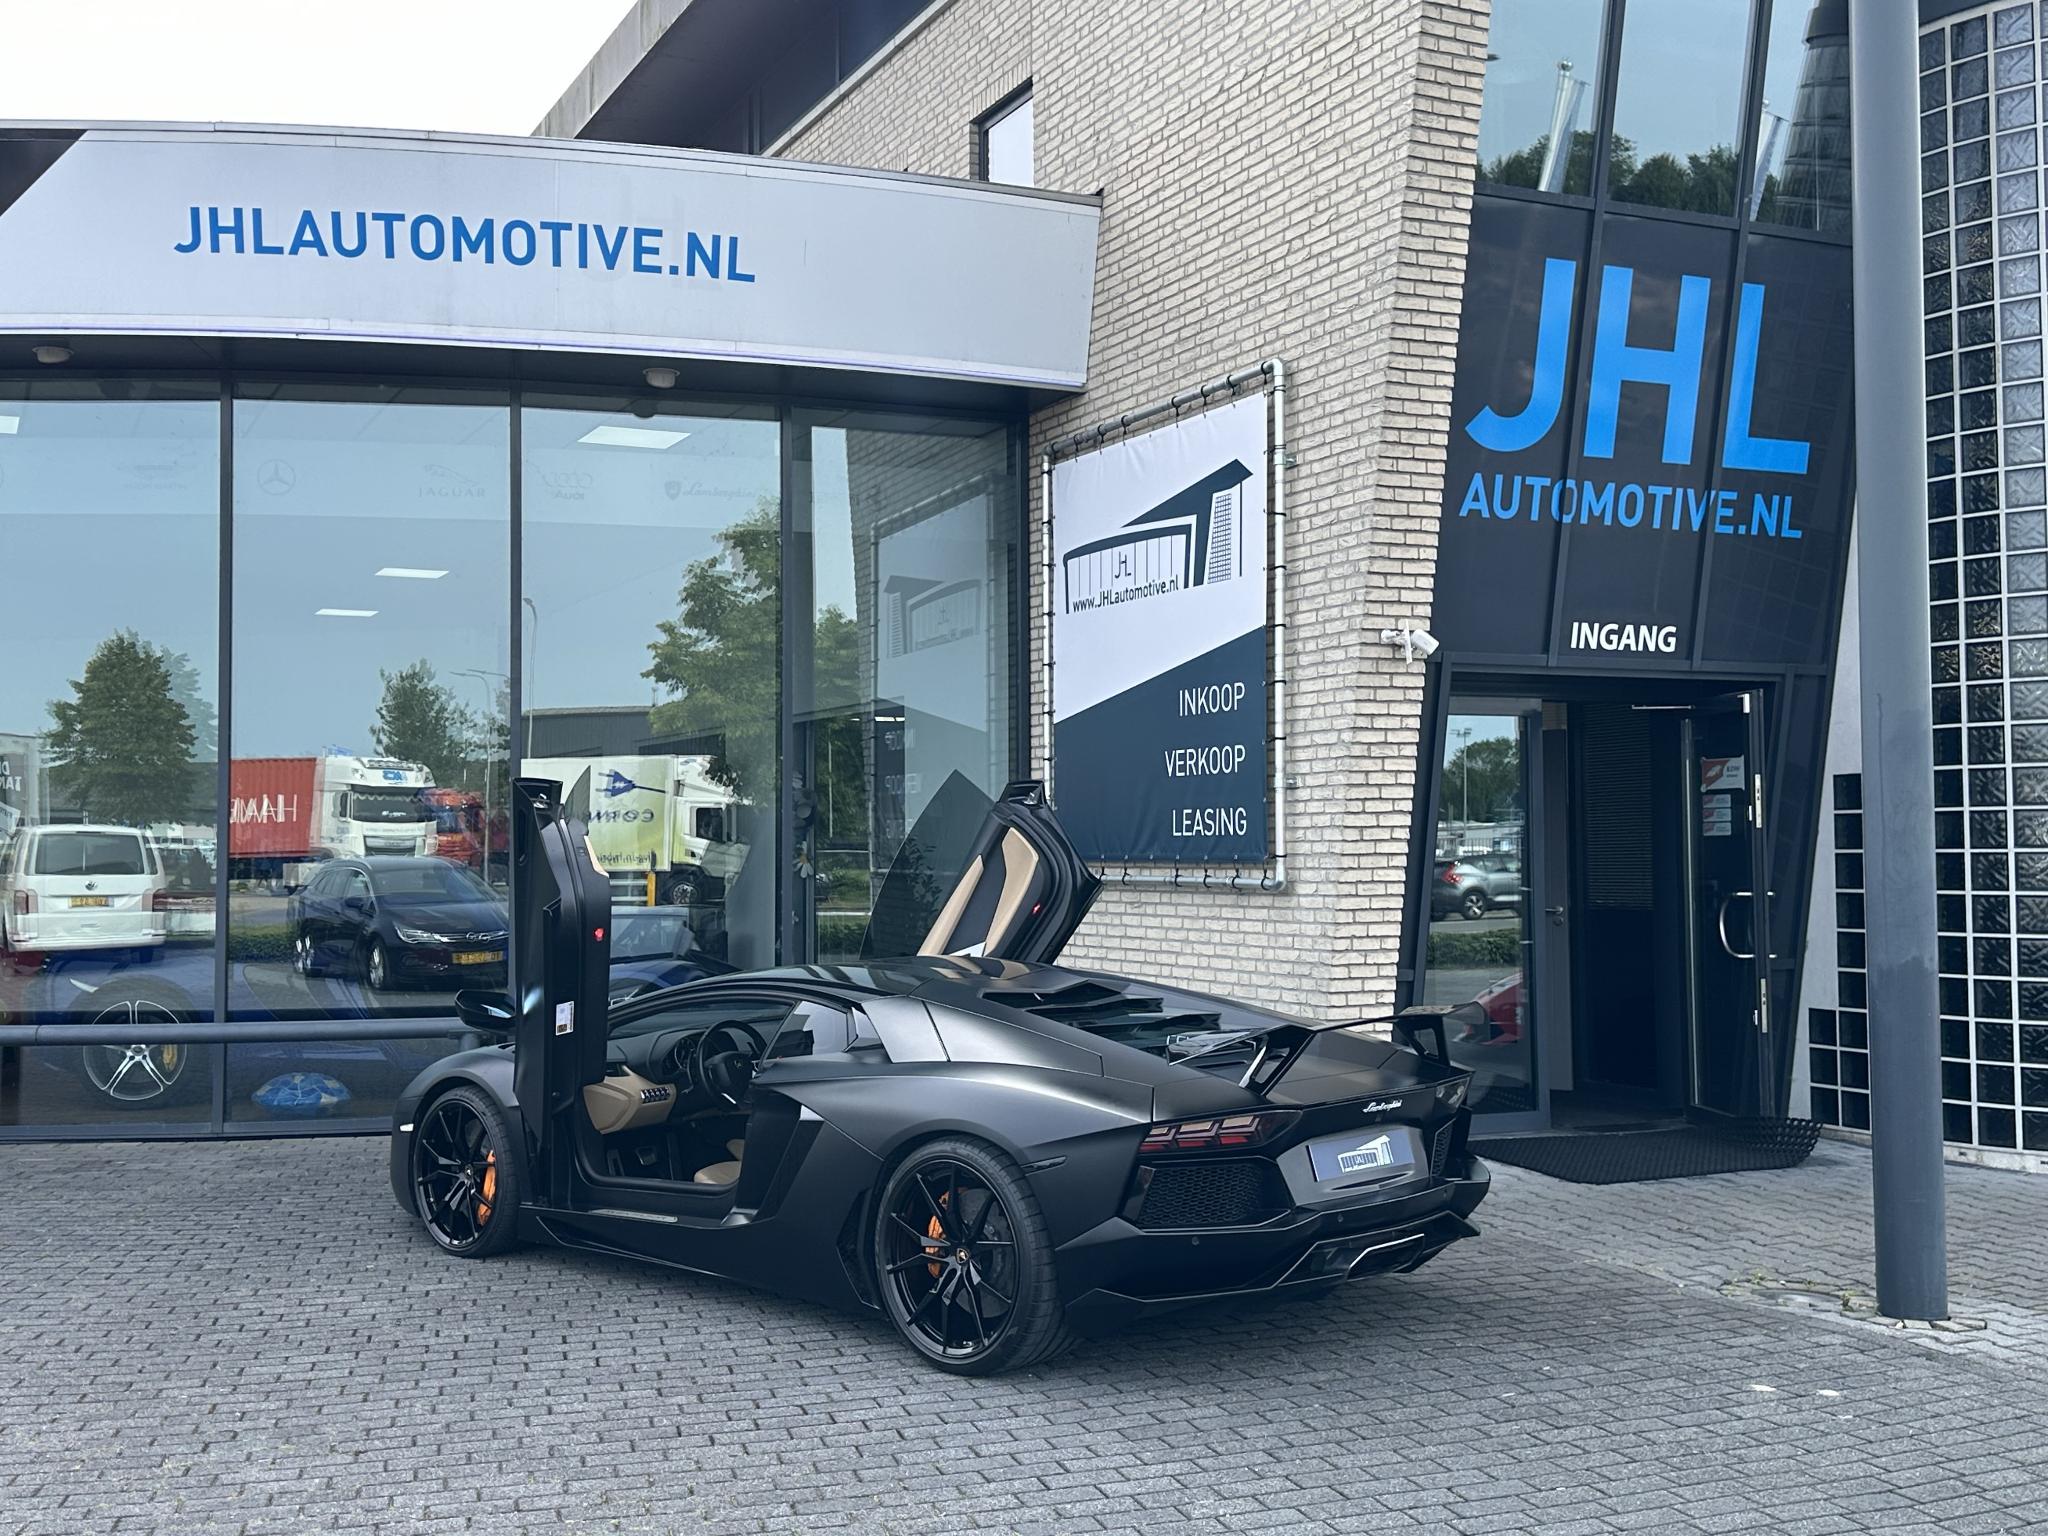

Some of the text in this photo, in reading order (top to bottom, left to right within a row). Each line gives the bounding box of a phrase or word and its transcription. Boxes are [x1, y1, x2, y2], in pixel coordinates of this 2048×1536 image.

[174, 206, 756, 283] JHLAUTOMOTIVE.NL
[1465, 257, 1810, 475] JHL
[1459, 472, 1804, 540] AUTOMOTIVE.NL
[1114, 553, 1132, 579] JHL
[1072, 574, 1179, 613] www.JHLautomotive.nl
[1570, 621, 1677, 653] INGANG
[1179, 681, 1246, 717] INKOOP
[1164, 744, 1246, 777] VERKOOP
[1172, 807, 1247, 837] LEASING
